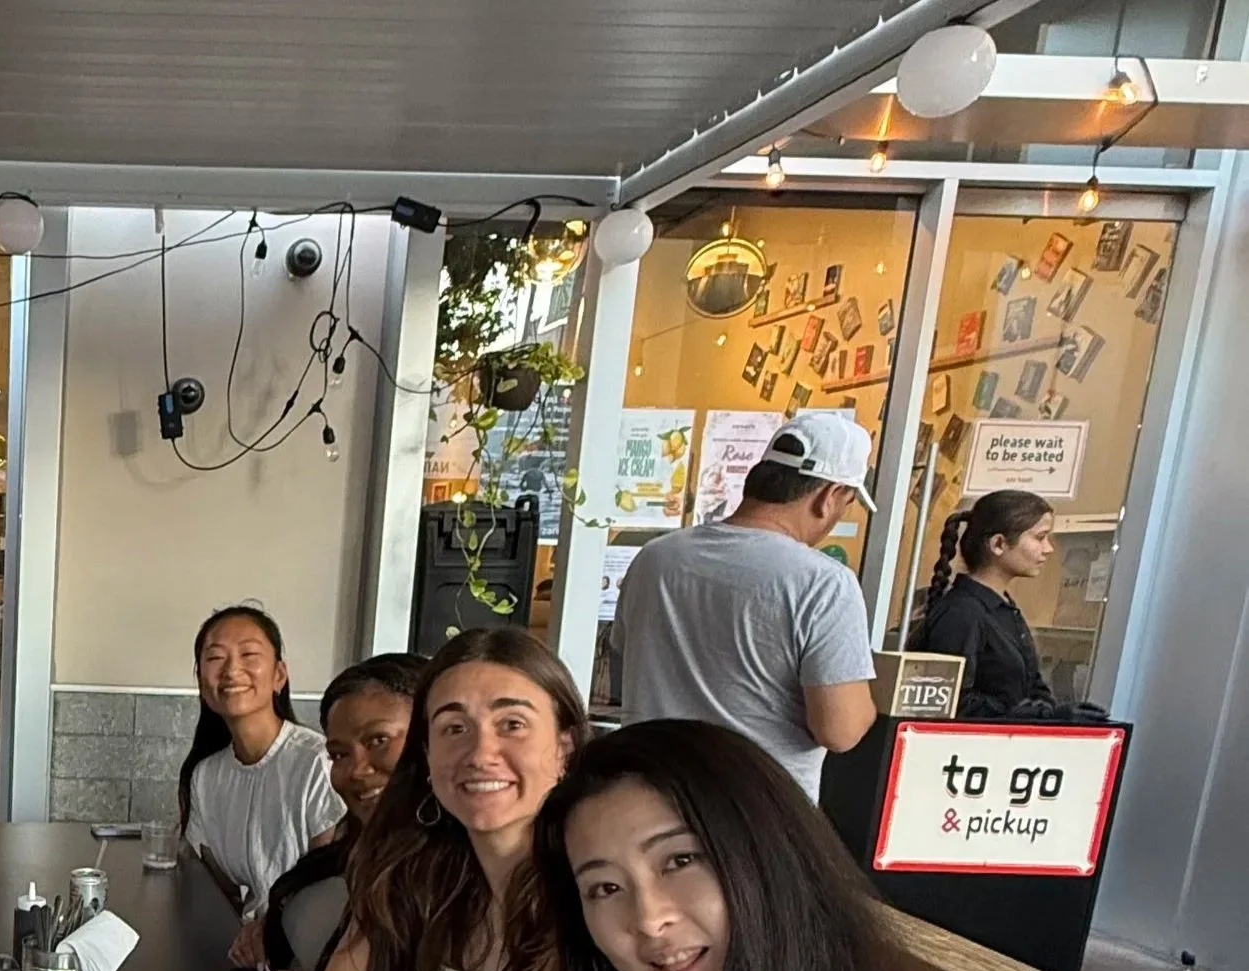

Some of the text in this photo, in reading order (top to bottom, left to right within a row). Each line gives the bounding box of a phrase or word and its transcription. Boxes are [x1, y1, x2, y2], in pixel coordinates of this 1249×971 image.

[990, 434, 1065, 449] please wait
[985, 449, 1065, 462] to be seated
[900, 684, 950, 706] TIPS
[942, 754, 1065, 807] to go
[941, 807, 1050, 844] & pickup
